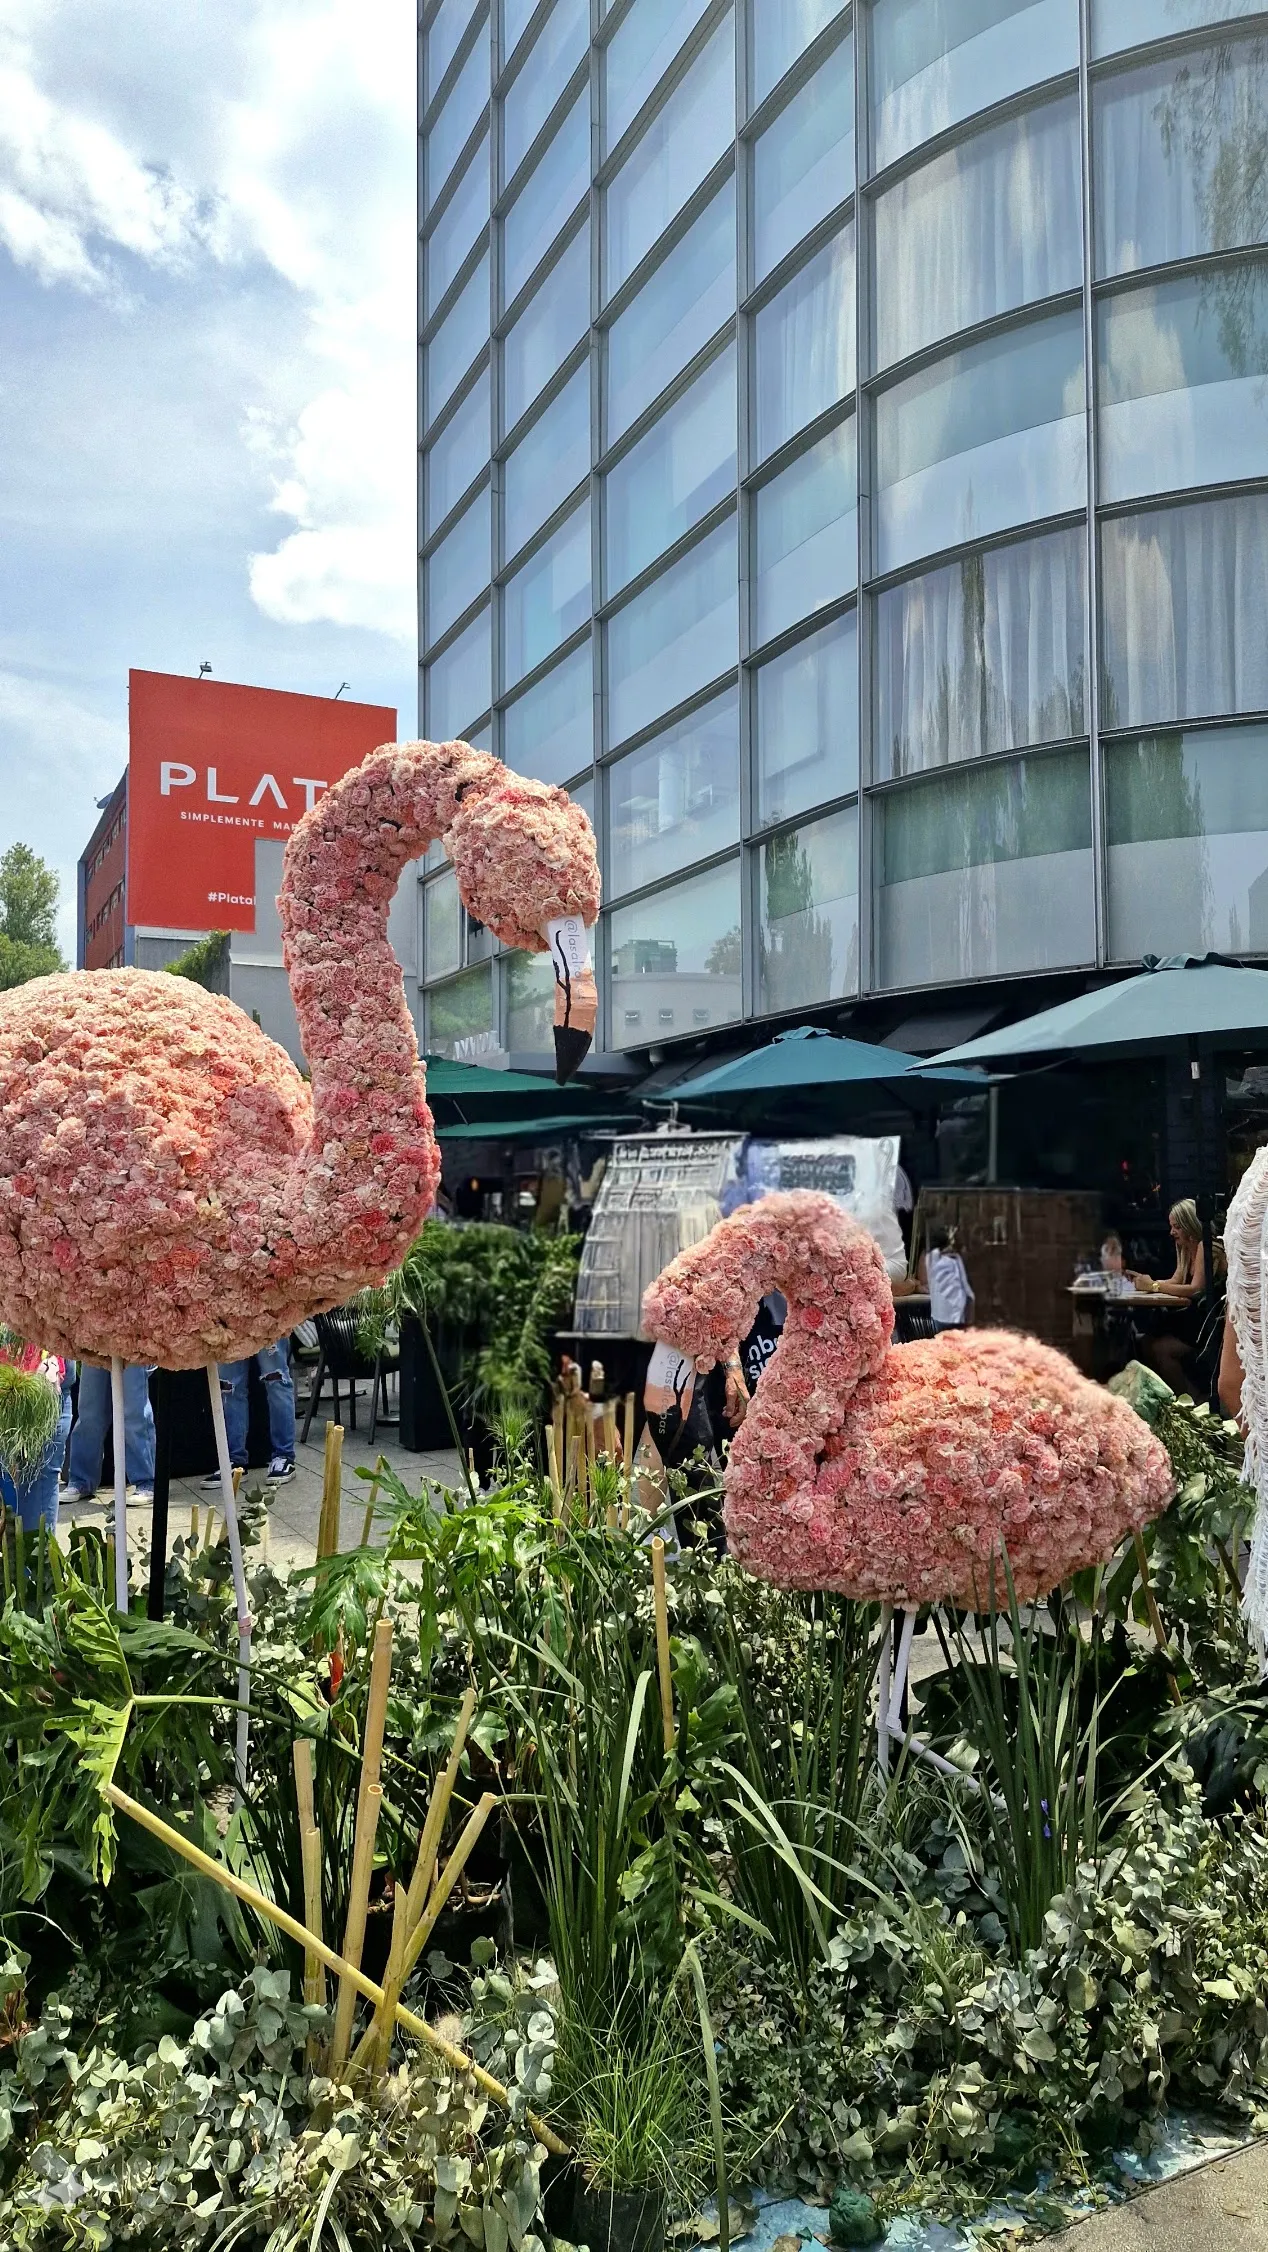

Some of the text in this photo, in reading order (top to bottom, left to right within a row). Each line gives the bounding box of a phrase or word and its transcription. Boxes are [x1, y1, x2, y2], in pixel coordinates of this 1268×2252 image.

[160, 761, 328, 811] PLAT
[180, 811, 298, 831] SIMPLEMENTE MAR
